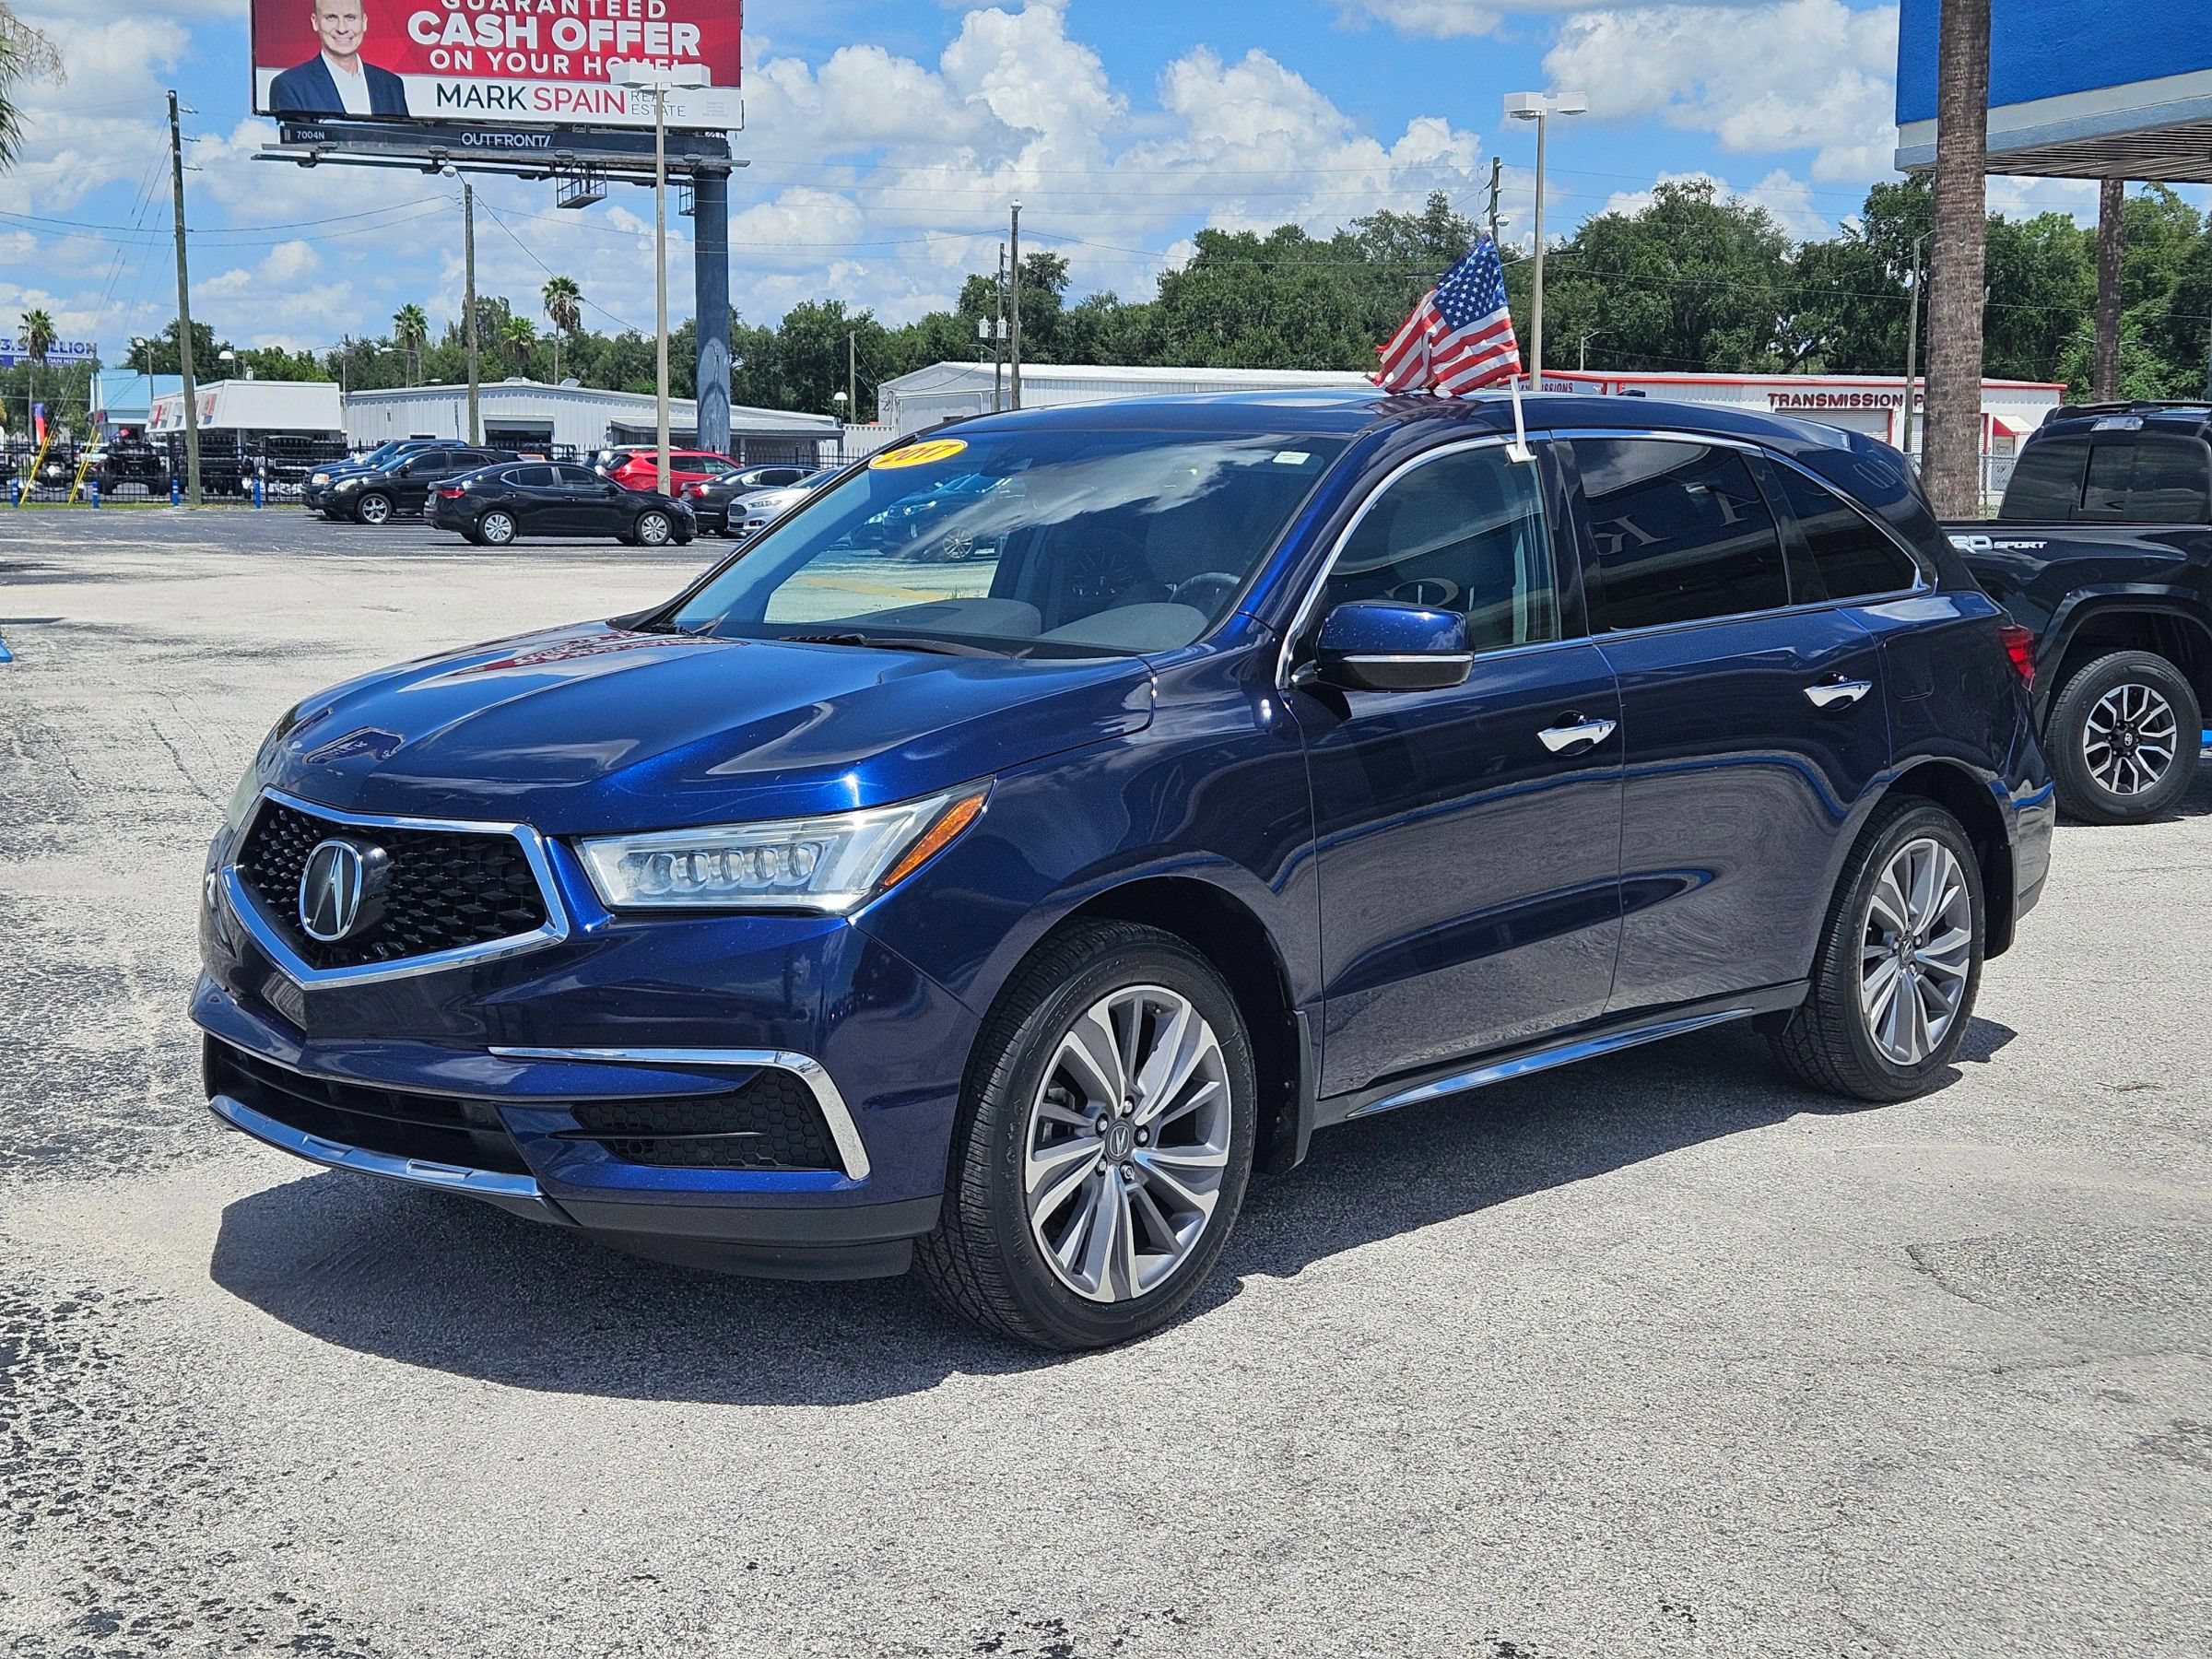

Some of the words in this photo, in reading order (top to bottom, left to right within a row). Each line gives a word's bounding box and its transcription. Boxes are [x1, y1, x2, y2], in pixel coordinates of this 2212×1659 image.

[441, 0, 666, 18] GUARANTEED
[407, 10, 538, 50] CASH
[551, 17, 701, 56] OFFER
[429, 49, 473, 70] ON
[486, 51, 570, 75] YOUR
[583, 55, 678, 75] HOE
[436, 83, 528, 111] MARK
[533, 87, 626, 114] SPAIN
[296, 130, 325, 140] 7004N
[1767, 393, 1903, 407] TRANSMISSION
[1994, 541, 2048, 549] SPORT
